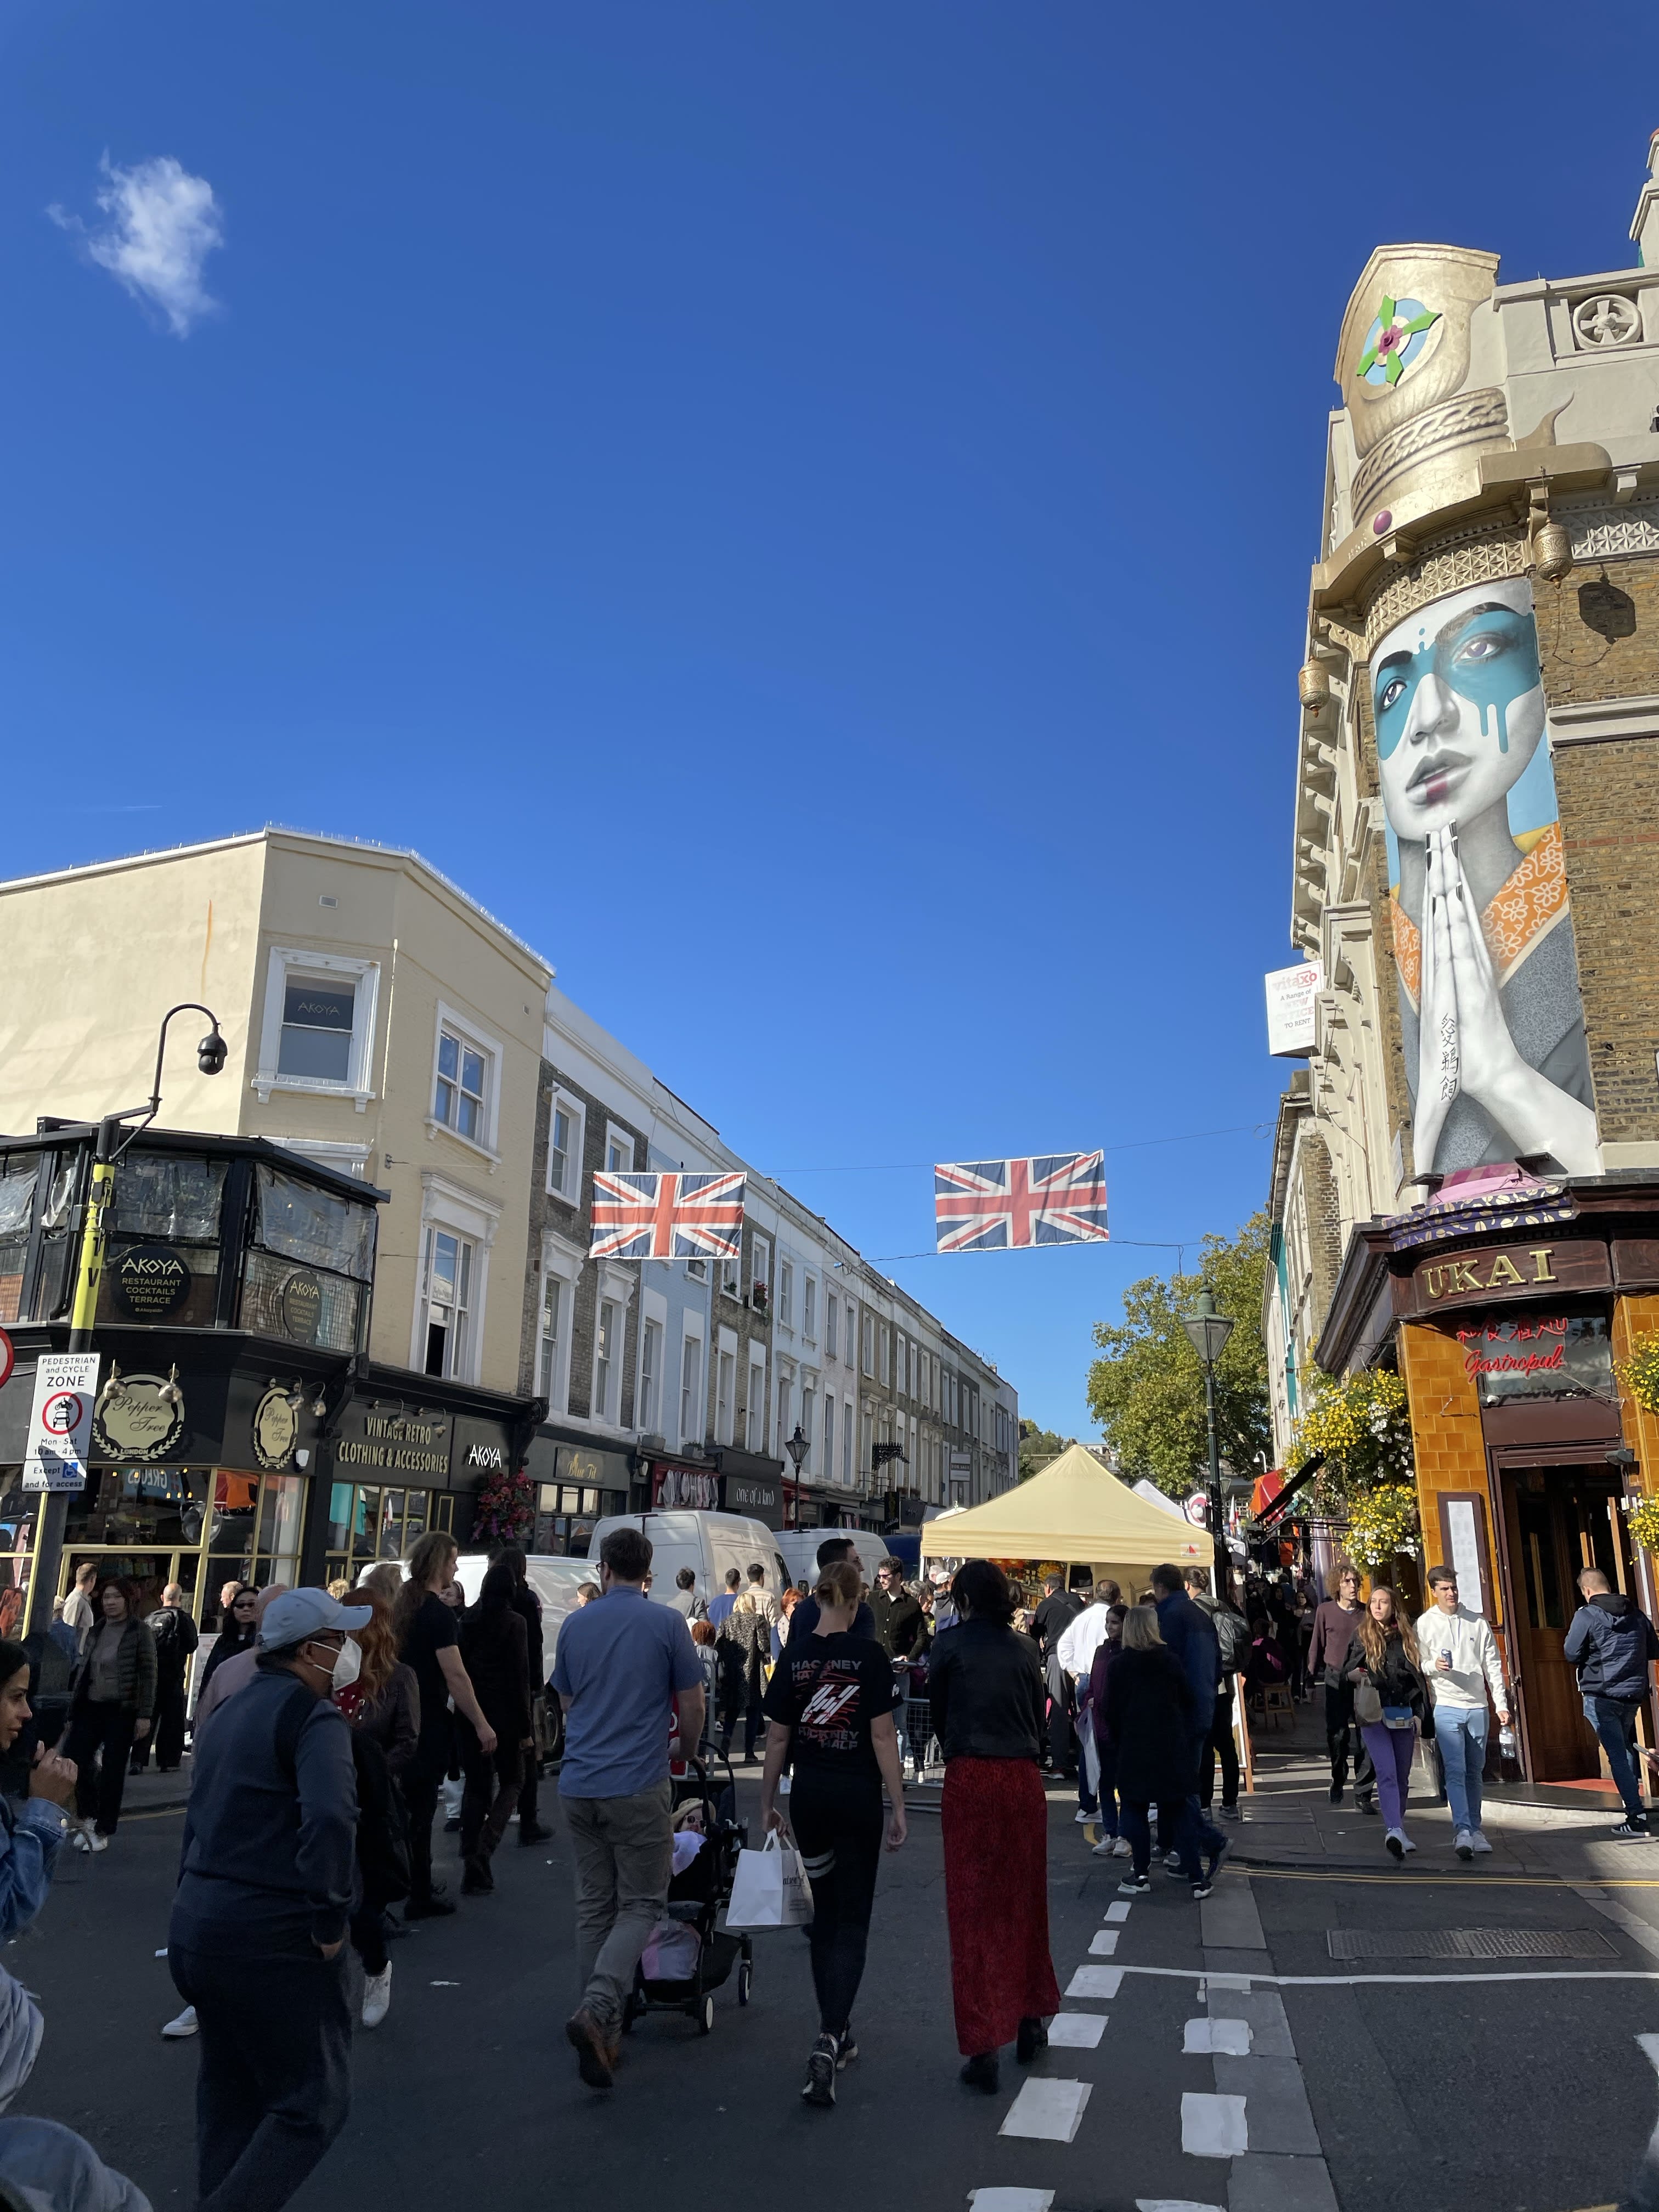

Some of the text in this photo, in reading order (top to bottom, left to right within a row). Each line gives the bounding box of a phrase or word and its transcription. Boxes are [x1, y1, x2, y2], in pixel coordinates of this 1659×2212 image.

[1286, 991, 1304, 1000] Range
[297, 1002, 340, 1017] AKOYA
[1294, 1018, 1311, 1027] RENT
[121, 1257, 184, 1275] AKOYA
[122, 1277, 182, 1286] RESTAURANT
[1421, 1249, 1558, 1299] UKAI
[126, 1286, 176, 1295] COCKTAILS
[289, 1280, 319, 1299] AKOYA
[129, 1296, 171, 1304] TERRACE
[42, 1356, 96, 1365] PEDESTRIAN
[1464, 1344, 1566, 1384] Gastropub
[47, 1376, 85, 1387] ZONE
[113, 1396, 162, 1417] Pepper
[264, 1407, 289, 1426] Pepper
[129, 1417, 165, 1432] Tree
[367, 1417, 431, 1445] VINTAGE RETRO
[339, 1441, 448, 1474] CLOTHING & ACCESSORIES
[469, 1444, 501, 1468] AKOYA
[33, 1466, 60, 1475] Except
